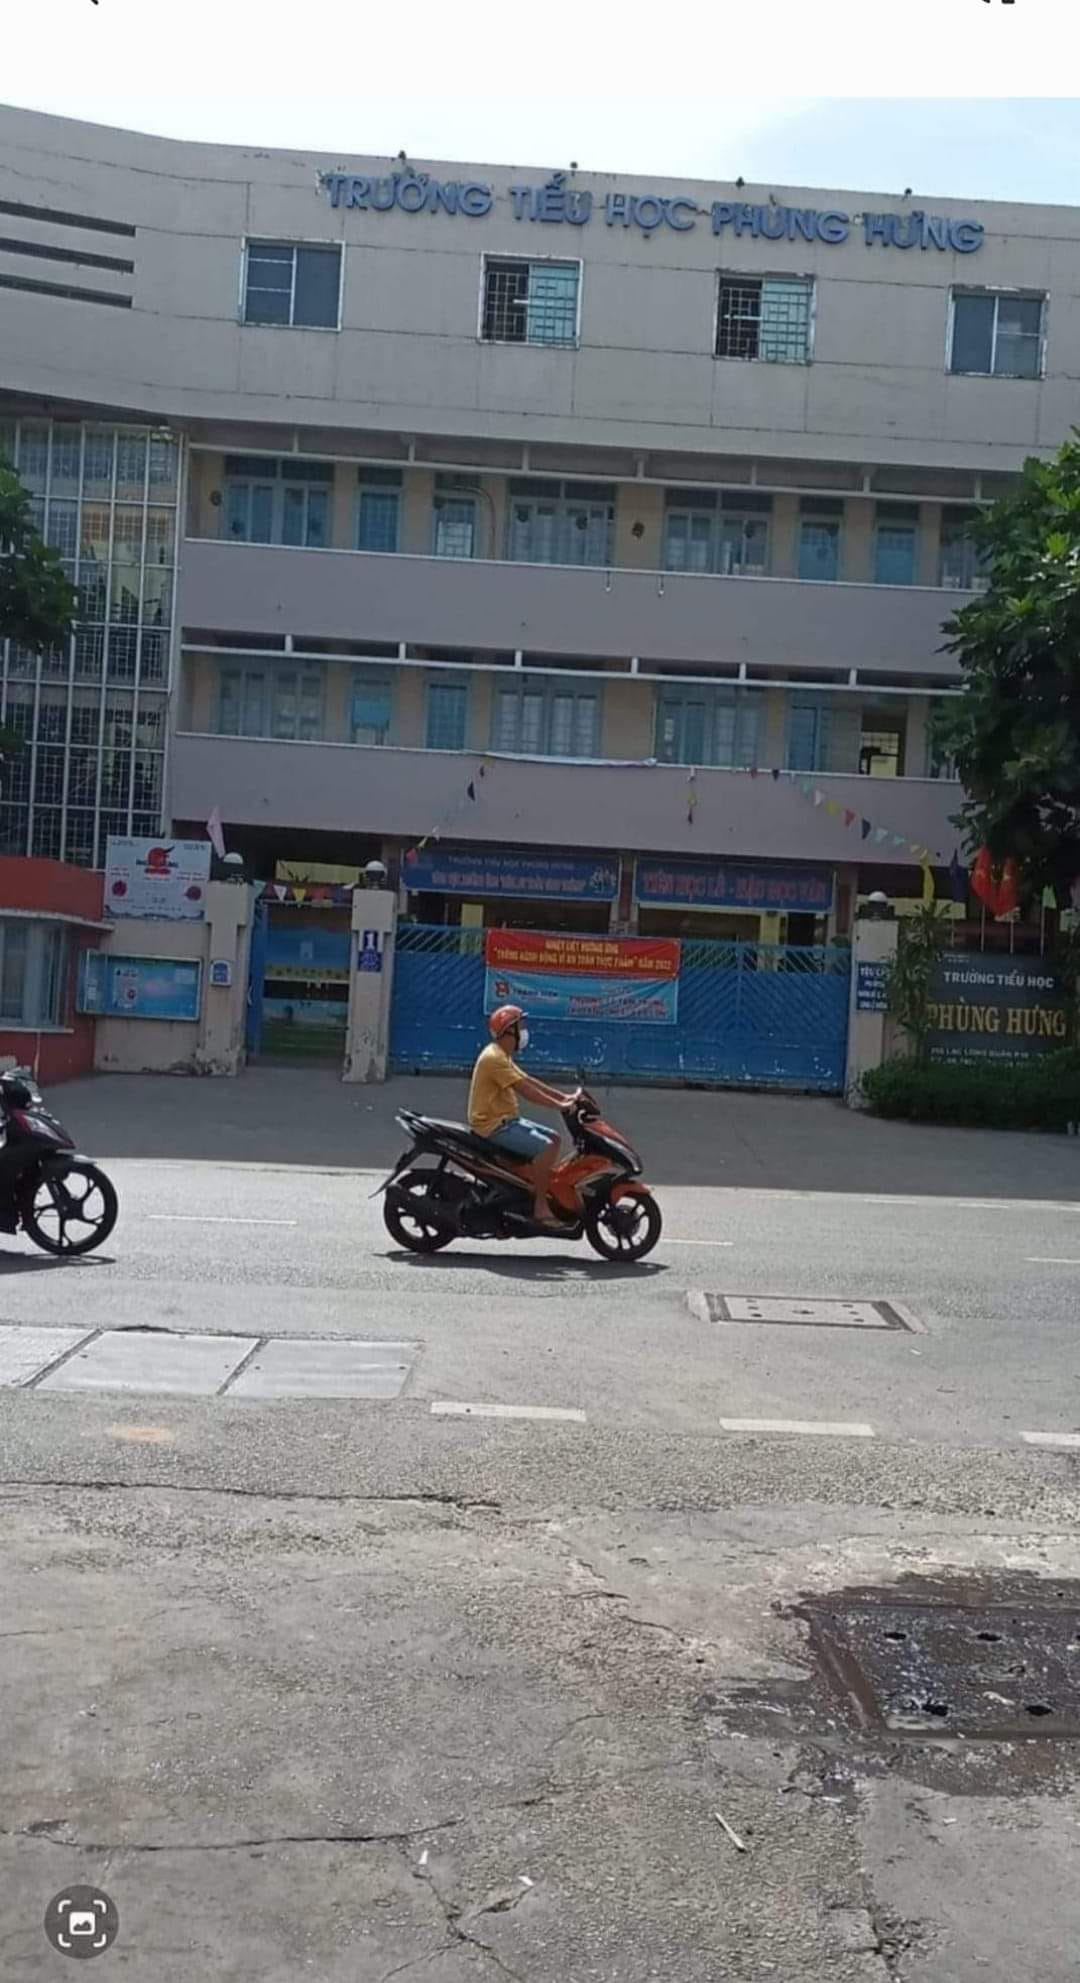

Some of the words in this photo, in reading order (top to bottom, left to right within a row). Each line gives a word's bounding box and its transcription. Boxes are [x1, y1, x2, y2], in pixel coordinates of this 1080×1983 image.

[325, 166, 493, 218] TRƯỜNG
[606, 192, 696, 239] HỌC
[711, 194, 850, 245] PHÙNG
[862, 209, 985, 254] HƯNG
[366, 933, 375, 950] 1
[943, 968, 995, 985] TRƯỜNG
[997, 968, 1025, 986] TIỂU
[1027, 974, 1055, 990] HỌC
[926, 996, 1001, 1034] PHÙNG
[1006, 1004, 1067, 1037] HƯNG
